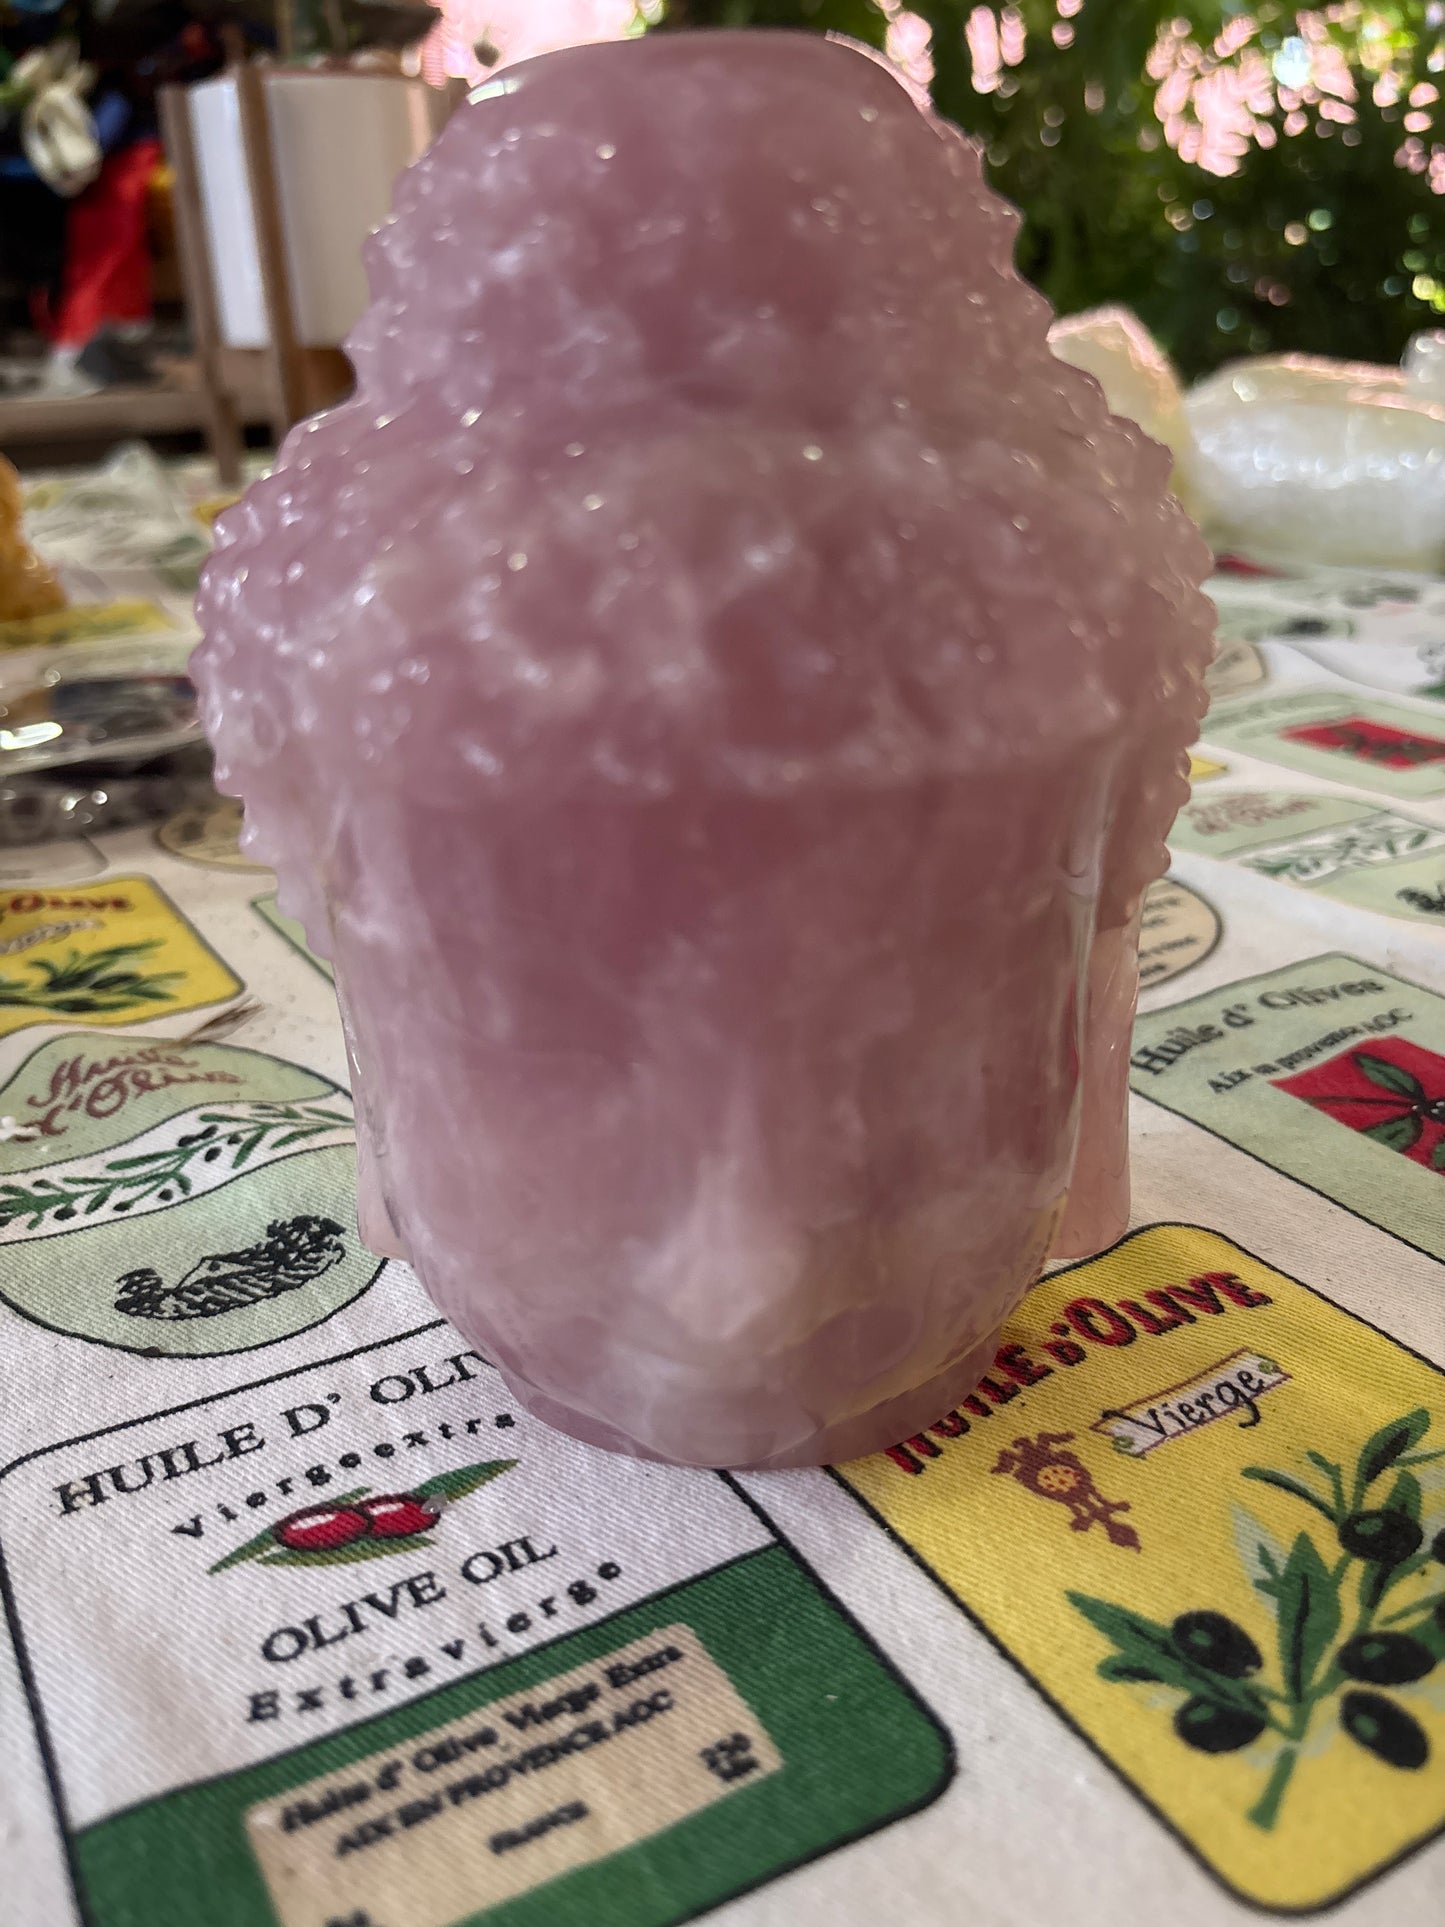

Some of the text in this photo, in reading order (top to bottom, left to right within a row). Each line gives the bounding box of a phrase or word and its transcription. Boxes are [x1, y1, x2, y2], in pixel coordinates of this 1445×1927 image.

[1130, 1024, 1224, 1076] Huile
[52, 1422, 266, 1518] HUILE
[279, 1392, 341, 1438] D'
[1101, 1367, 1265, 1429] Vierge
[261, 1536, 559, 1663] OLIVE OIL
[412, 1727, 498, 1772] Olive
[502, 1682, 600, 1730] Vierge
[605, 1646, 684, 1688] Extra
[447, 1719, 611, 1806] PROVENCE
[613, 1689, 674, 1732] AOC
